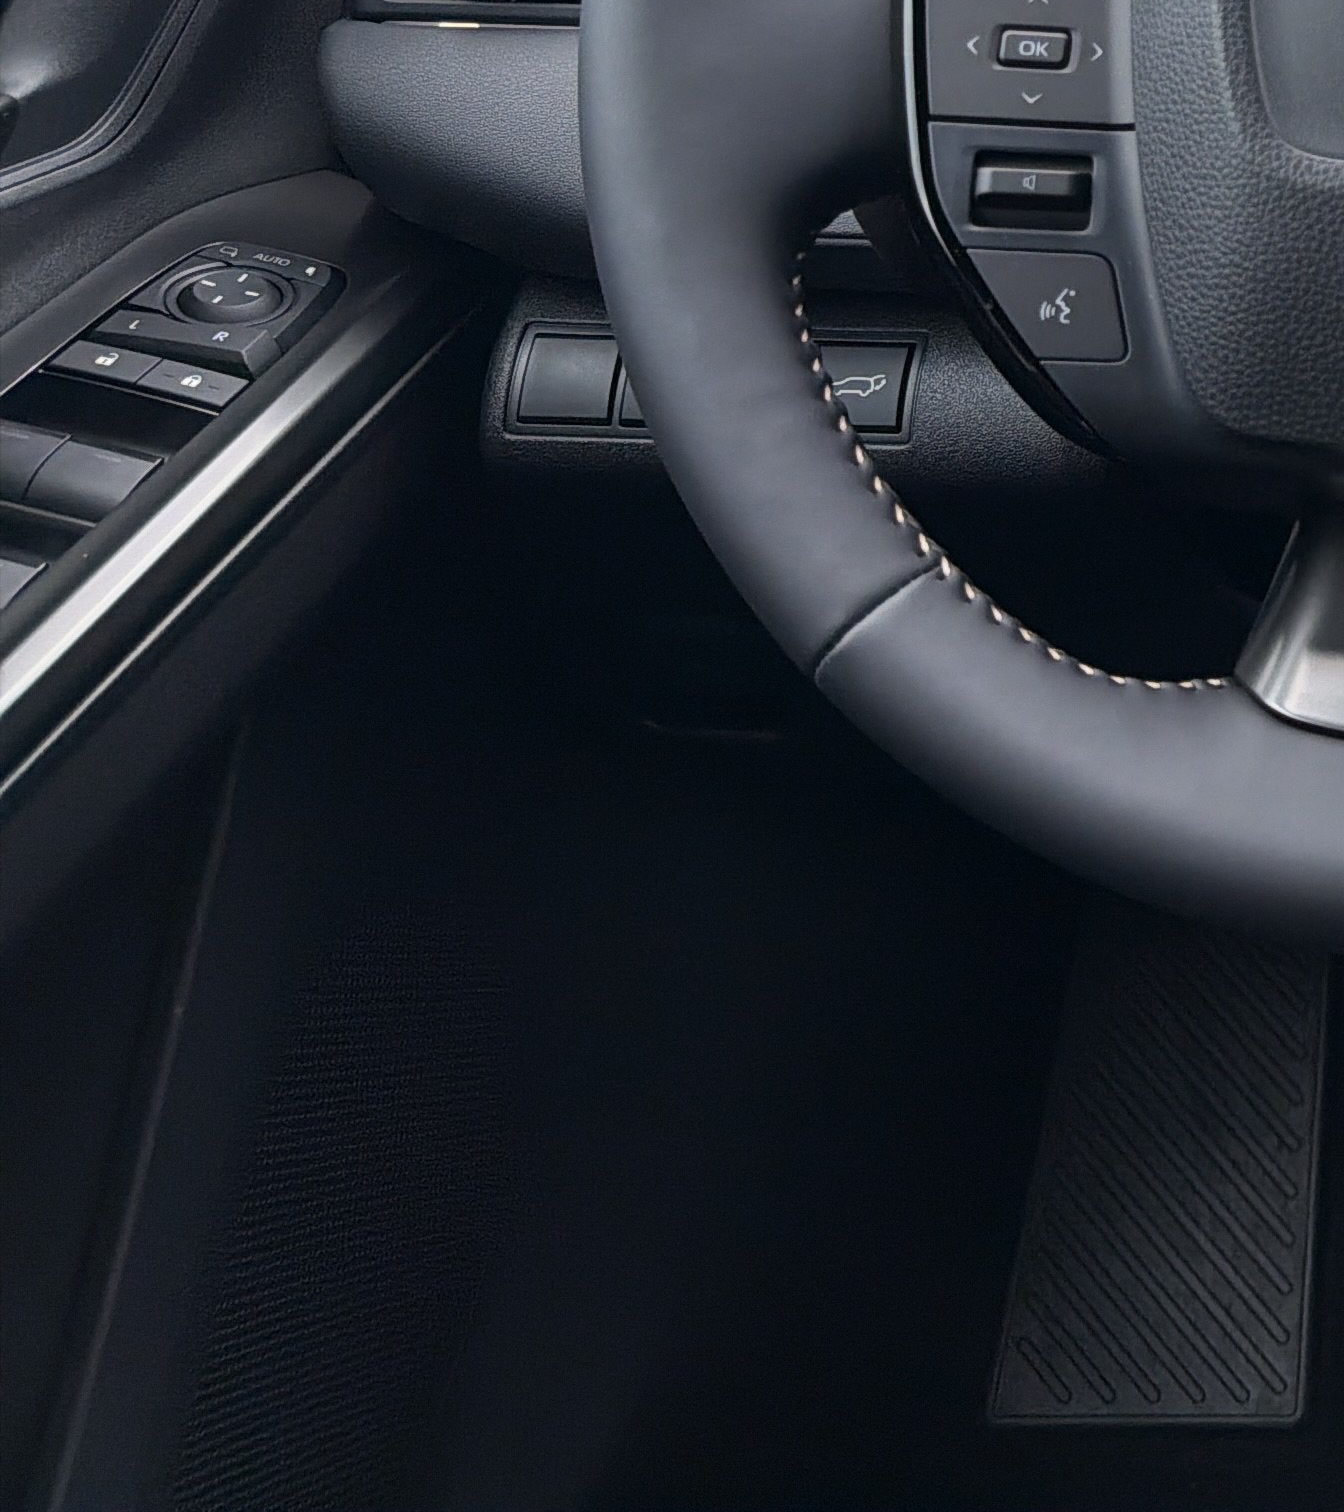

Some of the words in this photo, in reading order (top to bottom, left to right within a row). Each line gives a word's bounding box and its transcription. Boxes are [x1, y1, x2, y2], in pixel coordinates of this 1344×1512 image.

[1018, 40, 1049, 57] OK
[252, 252, 291, 267] AUTO
[211, 330, 230, 342] R
